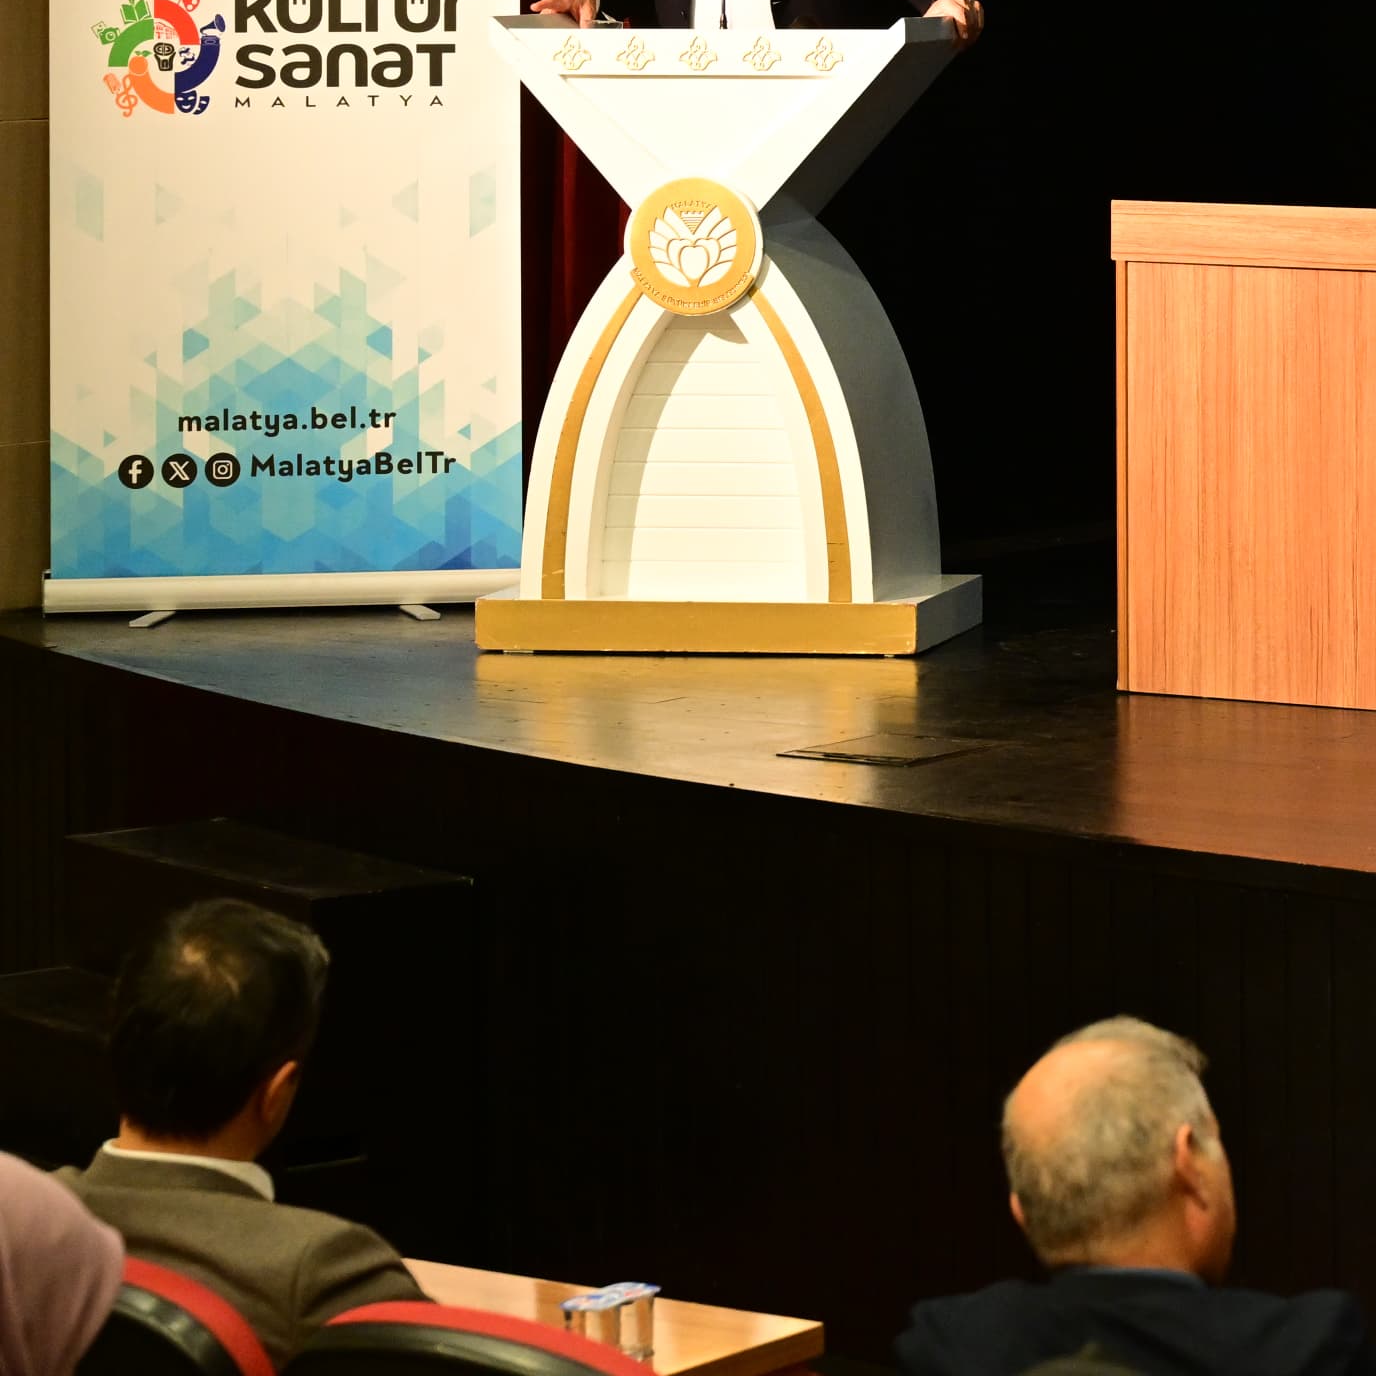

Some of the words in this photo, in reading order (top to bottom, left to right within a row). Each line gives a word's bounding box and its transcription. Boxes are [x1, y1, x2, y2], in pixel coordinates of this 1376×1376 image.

[233, 94, 444, 109] MALATYA
[177, 405, 398, 439] malatya.bel.tr
[250, 450, 457, 484] MalatyaBelTr
